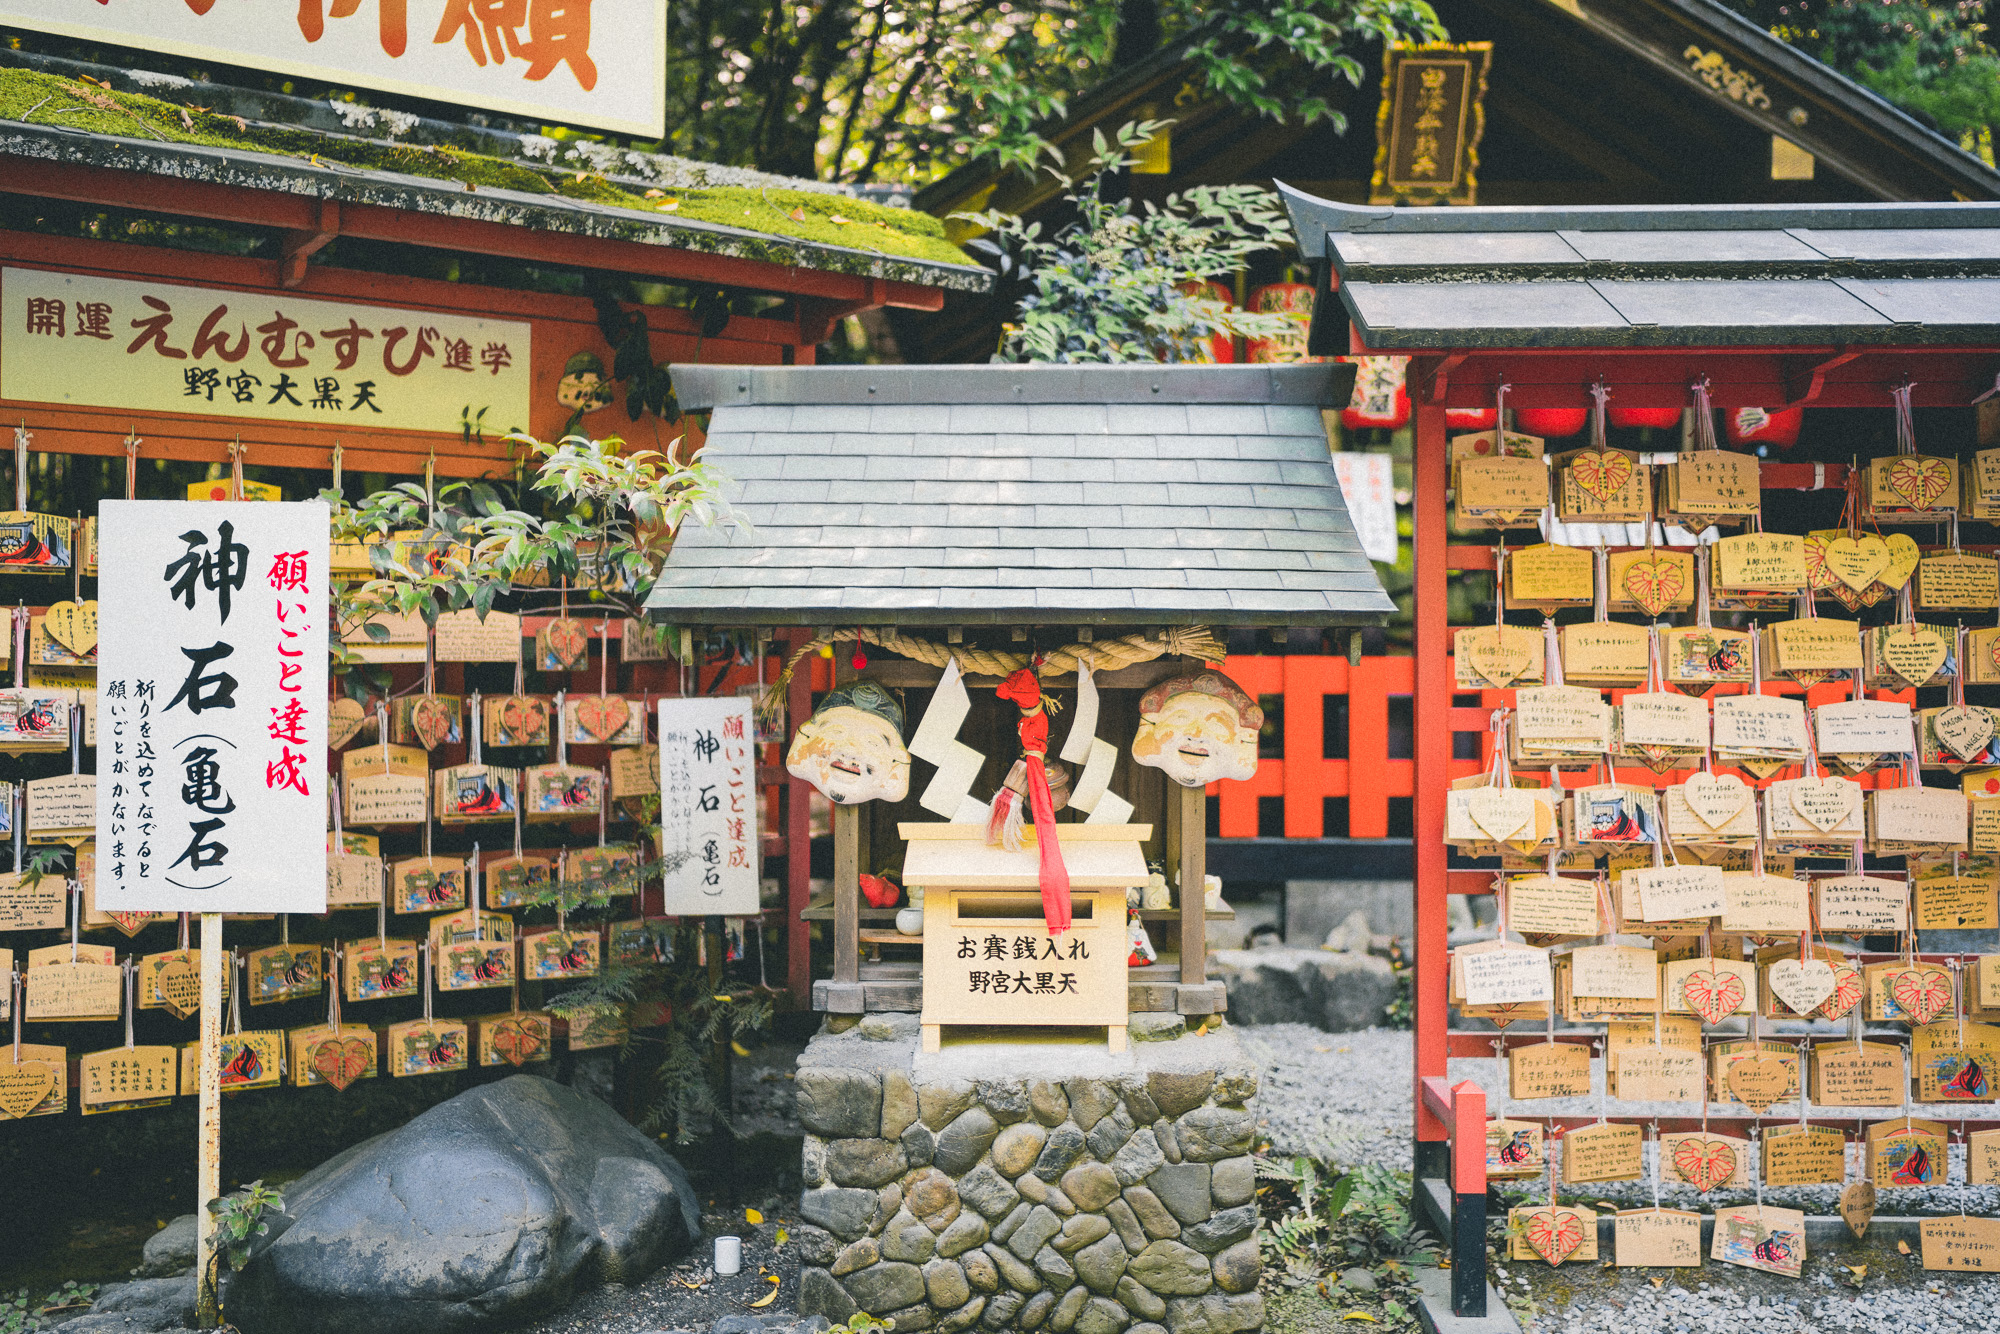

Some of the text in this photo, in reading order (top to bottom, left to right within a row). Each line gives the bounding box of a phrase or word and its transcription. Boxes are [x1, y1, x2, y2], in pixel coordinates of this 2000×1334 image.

[26, 295, 512, 376] 開運 えんむすび 進学
[183, 367, 383, 413] 野宮大黒天
[266, 549, 310, 796] 願いごと達成
[133, 678, 158, 878] 祈りを込めてなでると
[722, 713, 750, 869] 願いごと達成
[956, 934, 1090, 962] お賽銭入れ
[969, 970, 1079, 995] 野宮大黒天
